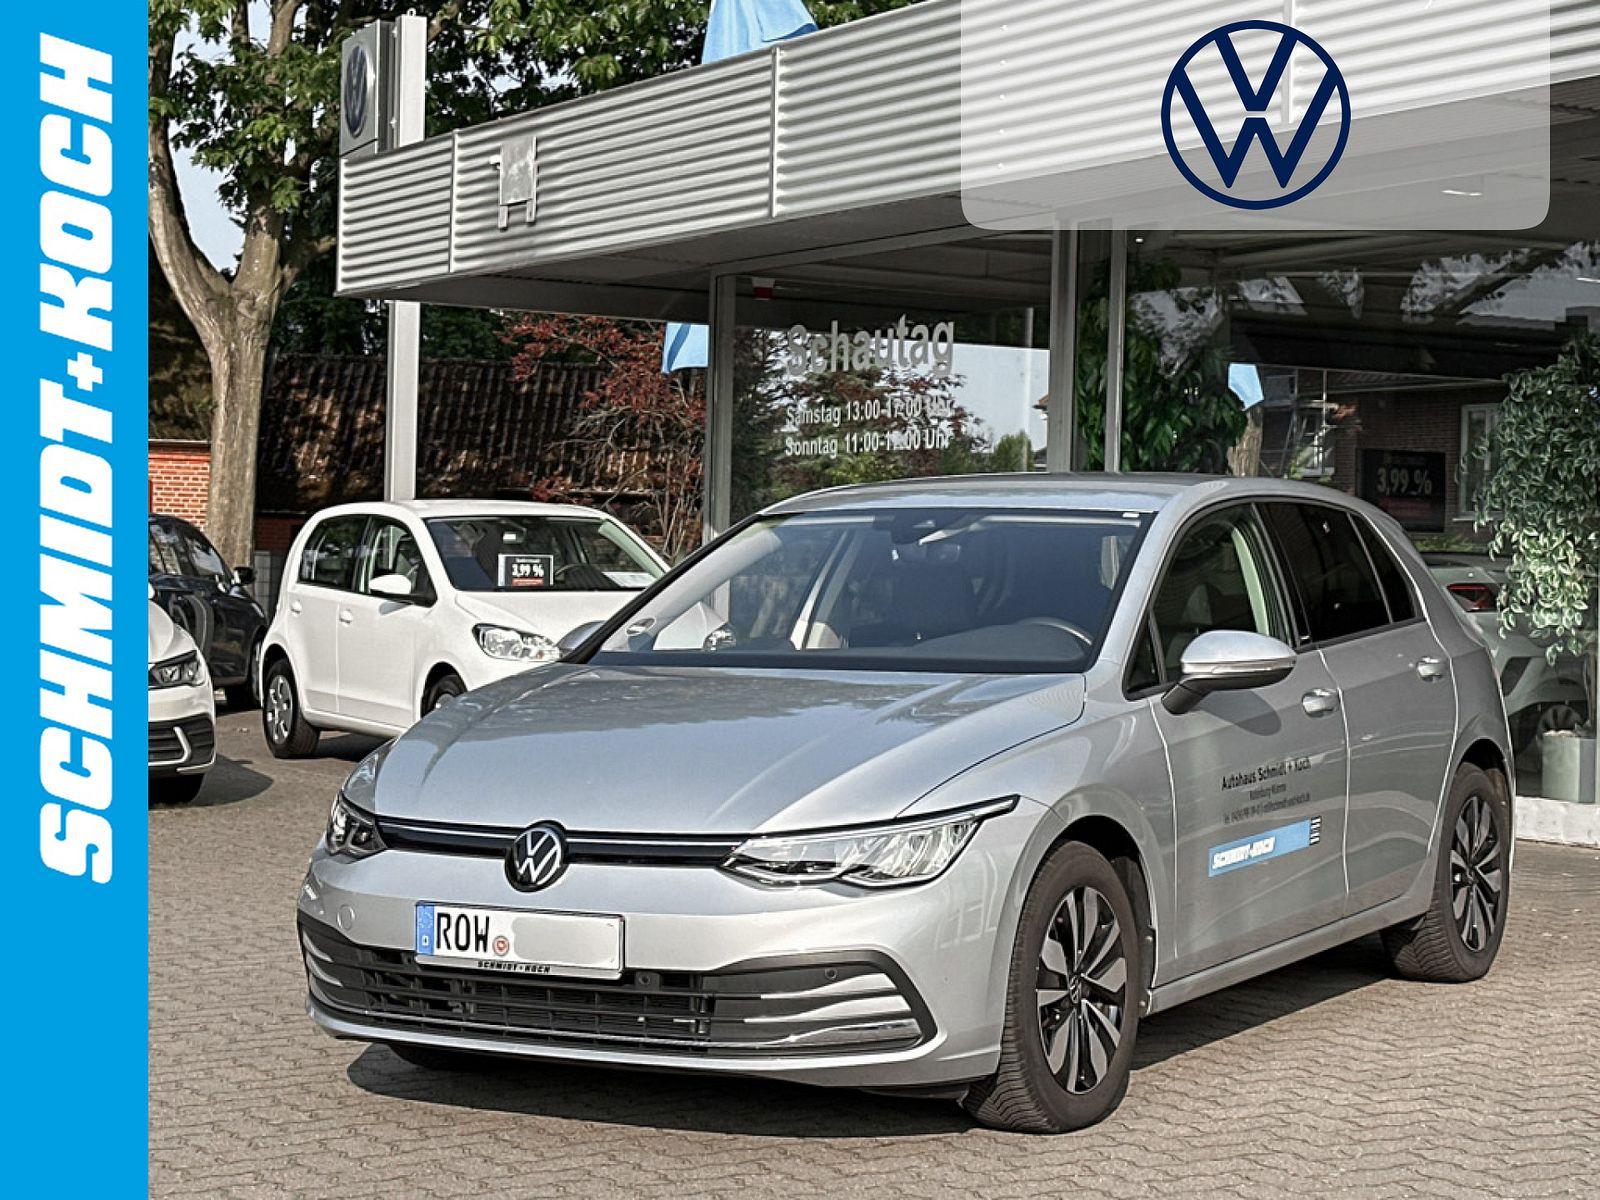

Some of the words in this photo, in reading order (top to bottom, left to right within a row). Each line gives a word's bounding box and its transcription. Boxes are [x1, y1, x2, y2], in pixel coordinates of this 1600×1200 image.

[787, 314, 954, 378] Schautag
[786, 404, 842, 427] Samstag
[785, 436, 838, 460] Sonntag
[844, 428, 921, 453] 11:00-1:00
[1376, 467, 1409, 496] 3,99
[1413, 468, 1432, 496] %
[436, 912, 490, 953] ROW
